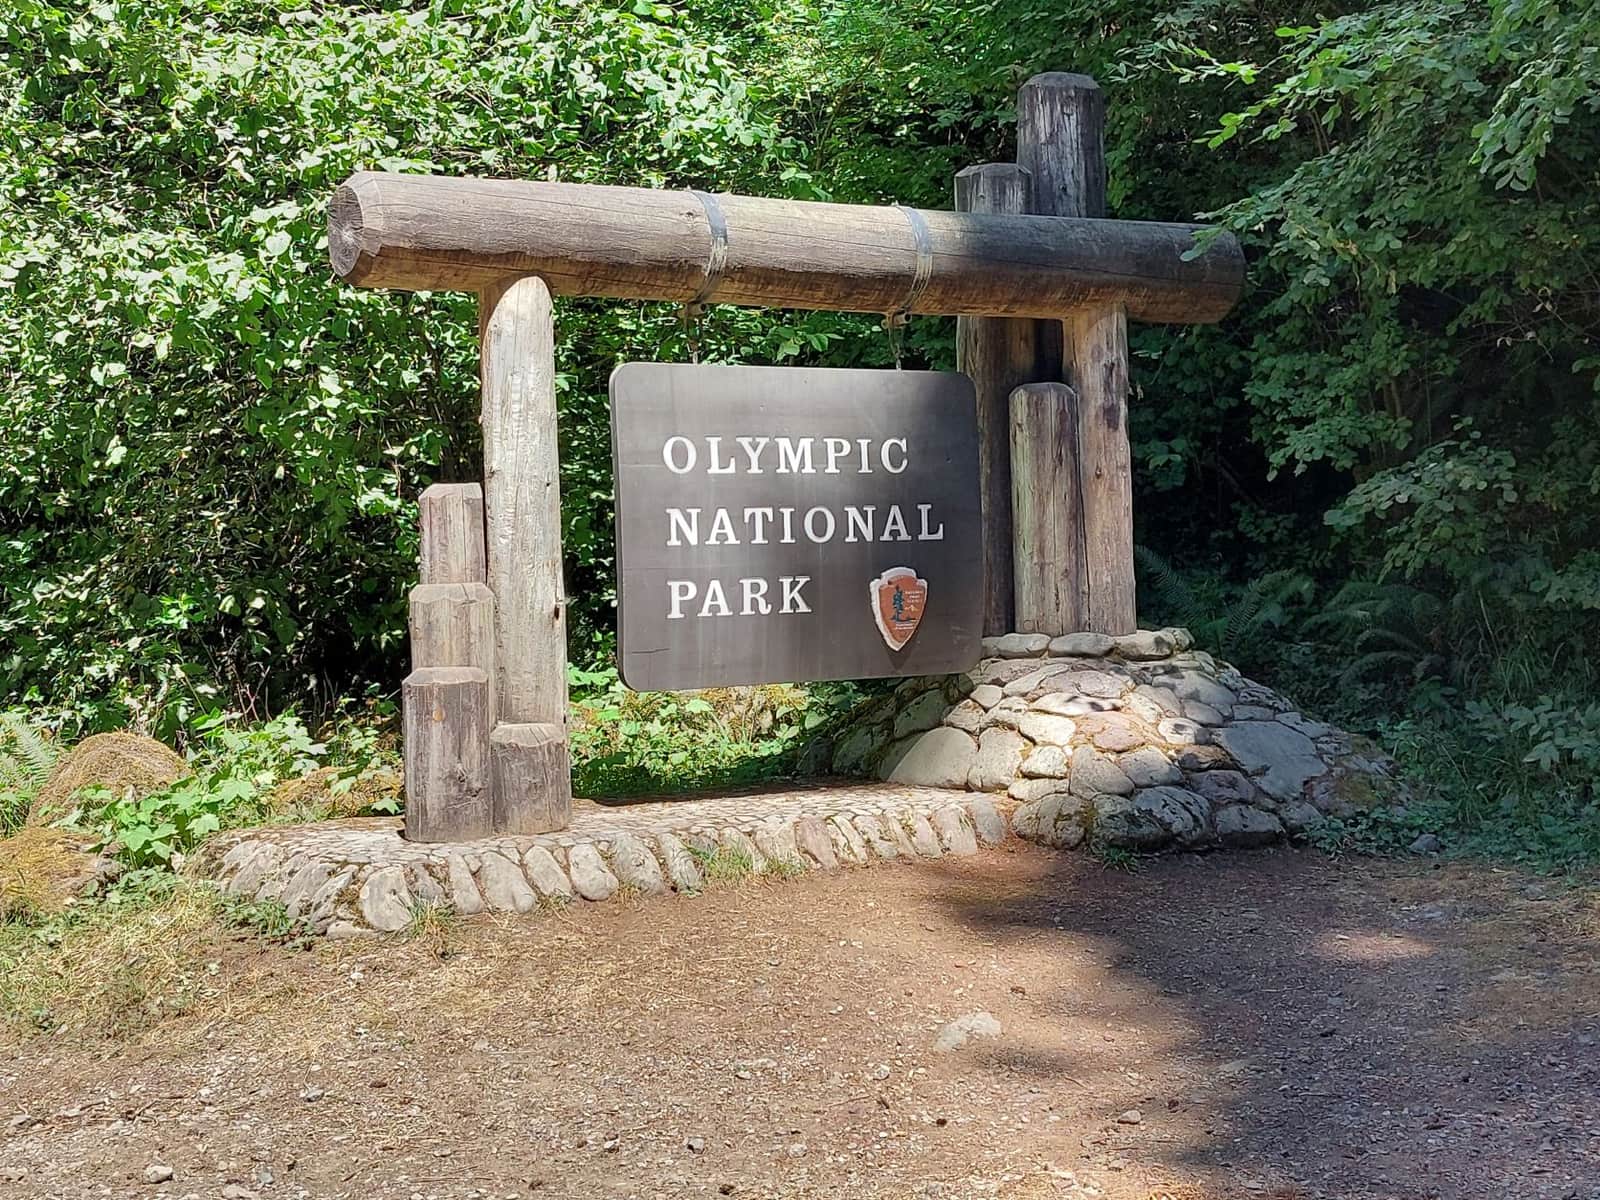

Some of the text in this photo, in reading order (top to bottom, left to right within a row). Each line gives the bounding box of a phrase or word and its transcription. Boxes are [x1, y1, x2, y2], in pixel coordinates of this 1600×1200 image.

[662, 436, 908, 474] OLYMPIC
[666, 504, 944, 546] NATIONAL
[666, 576, 812, 619] PARK
